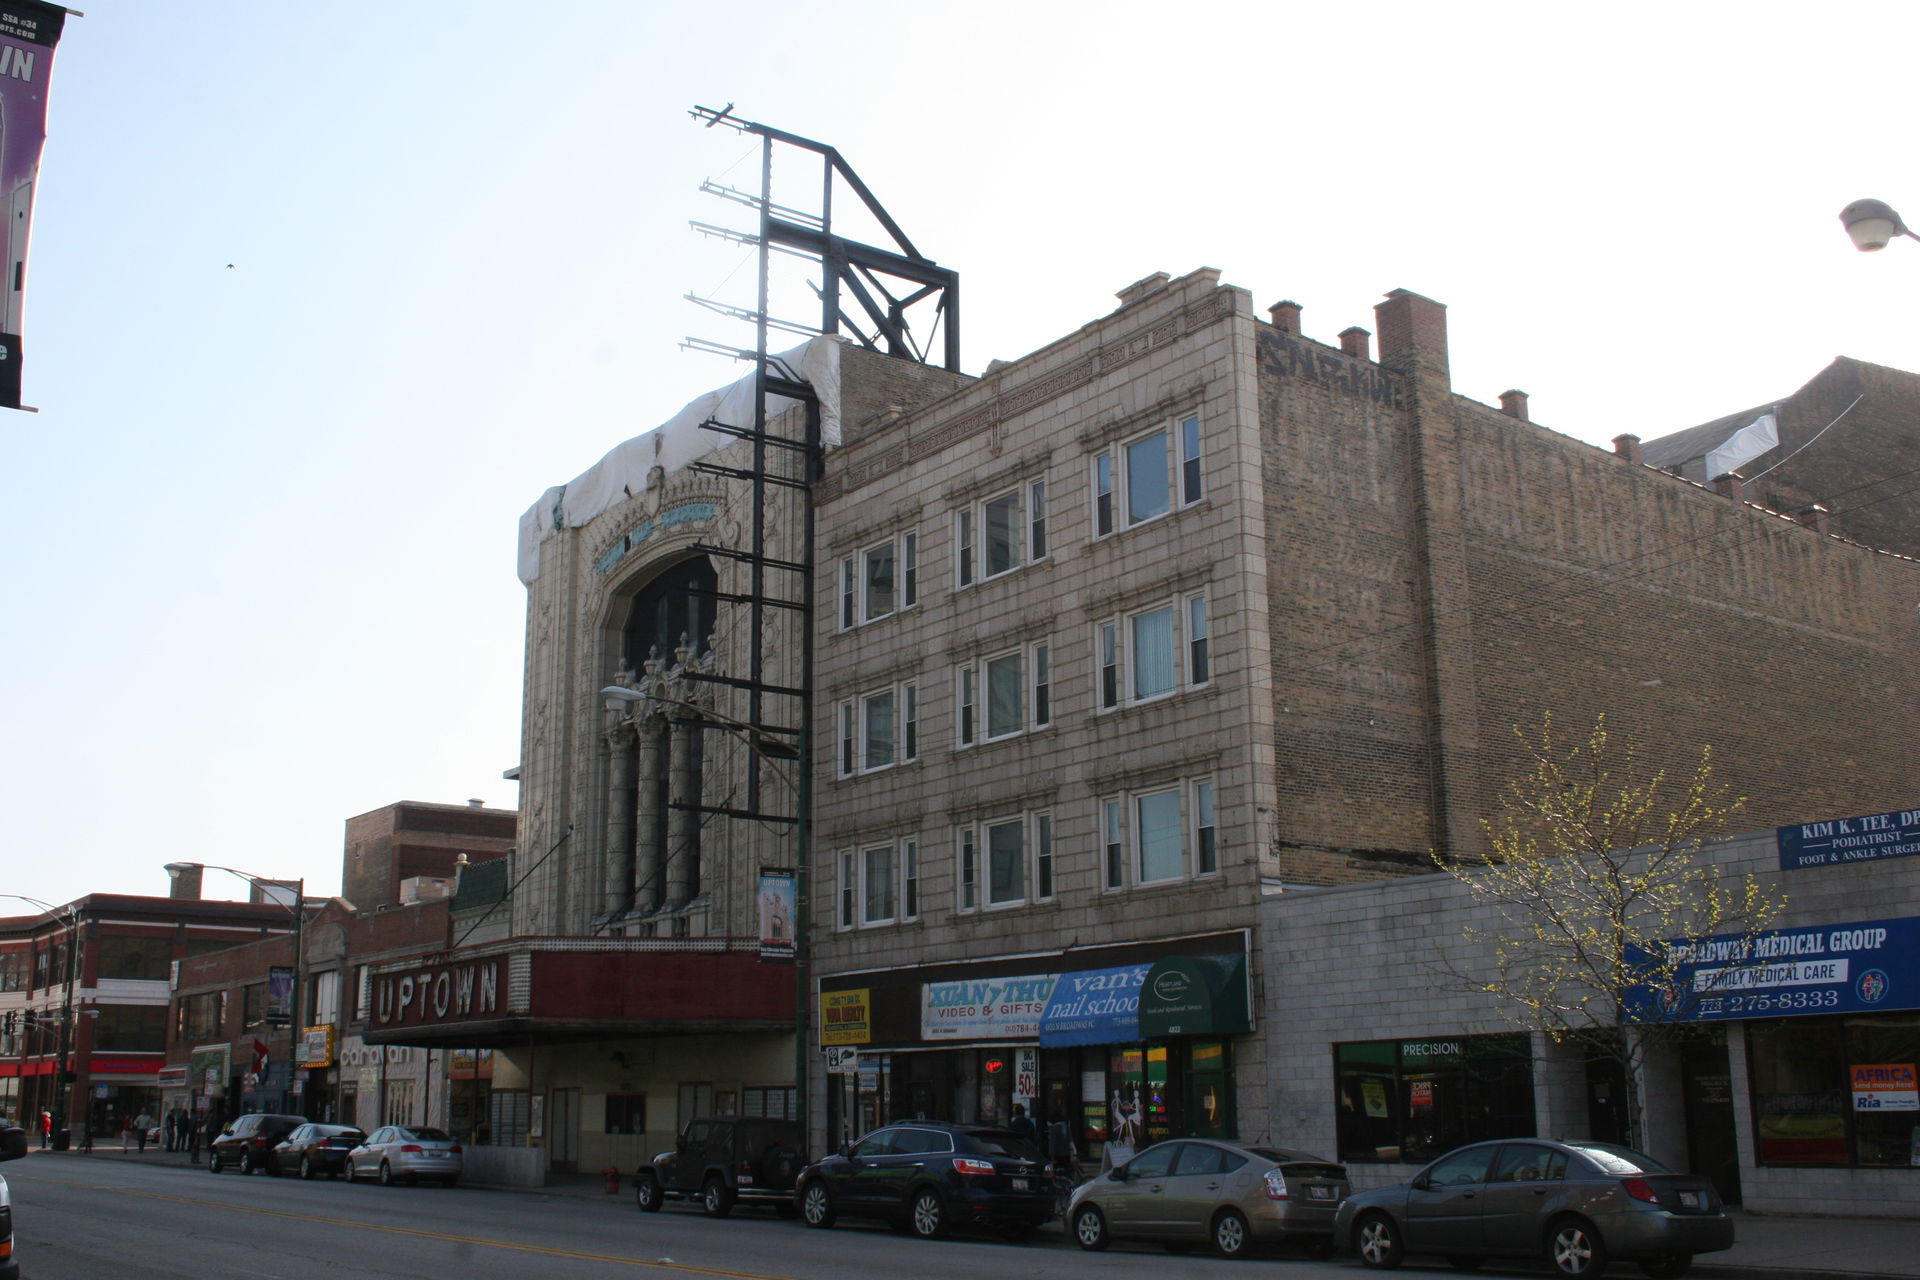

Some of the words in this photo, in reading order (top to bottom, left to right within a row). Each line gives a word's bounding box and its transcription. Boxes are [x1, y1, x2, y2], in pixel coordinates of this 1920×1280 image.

[2, 13, 18, 25] SSA
[1801, 821, 1834, 839] KIM
[1839, 819, 1855, 834] K.
[1859, 814, 1896, 831] TEE,
[1832, 830, 1902, 849] PODIATRIST
[1798, 854, 1826, 865] FOOT
[1830, 852, 1838, 862] &
[1842, 848, 1878, 860] ANKLE
[1881, 842, 1920, 856] SURGE
[1754, 933, 1825, 958] MEDICAL
[1829, 928, 1887, 952] GROUP
[1073, 968, 1149, 993] van's
[1704, 970, 1746, 987] FAMILY
[1749, 967, 1800, 984] MEDICAL
[1804, 963, 1836, 980] CARE
[379, 961, 498, 1024] UPTOWN
[1003, 979, 1056, 1003] THU
[938, 1006, 976, 1018] VIDEO
[982, 1005, 993, 1016] &
[1000, 1003, 1043, 1015] GIFTS
[1048, 992, 1088, 1019] nail
[1024, 1051, 1033, 1060] BIG
[1403, 1042, 1459, 1056] PRECISION
[1022, 1062, 1035, 1072] SALE
[1855, 1068, 1914, 1081] AFRICA
[1857, 1094, 1881, 1109] Ria
